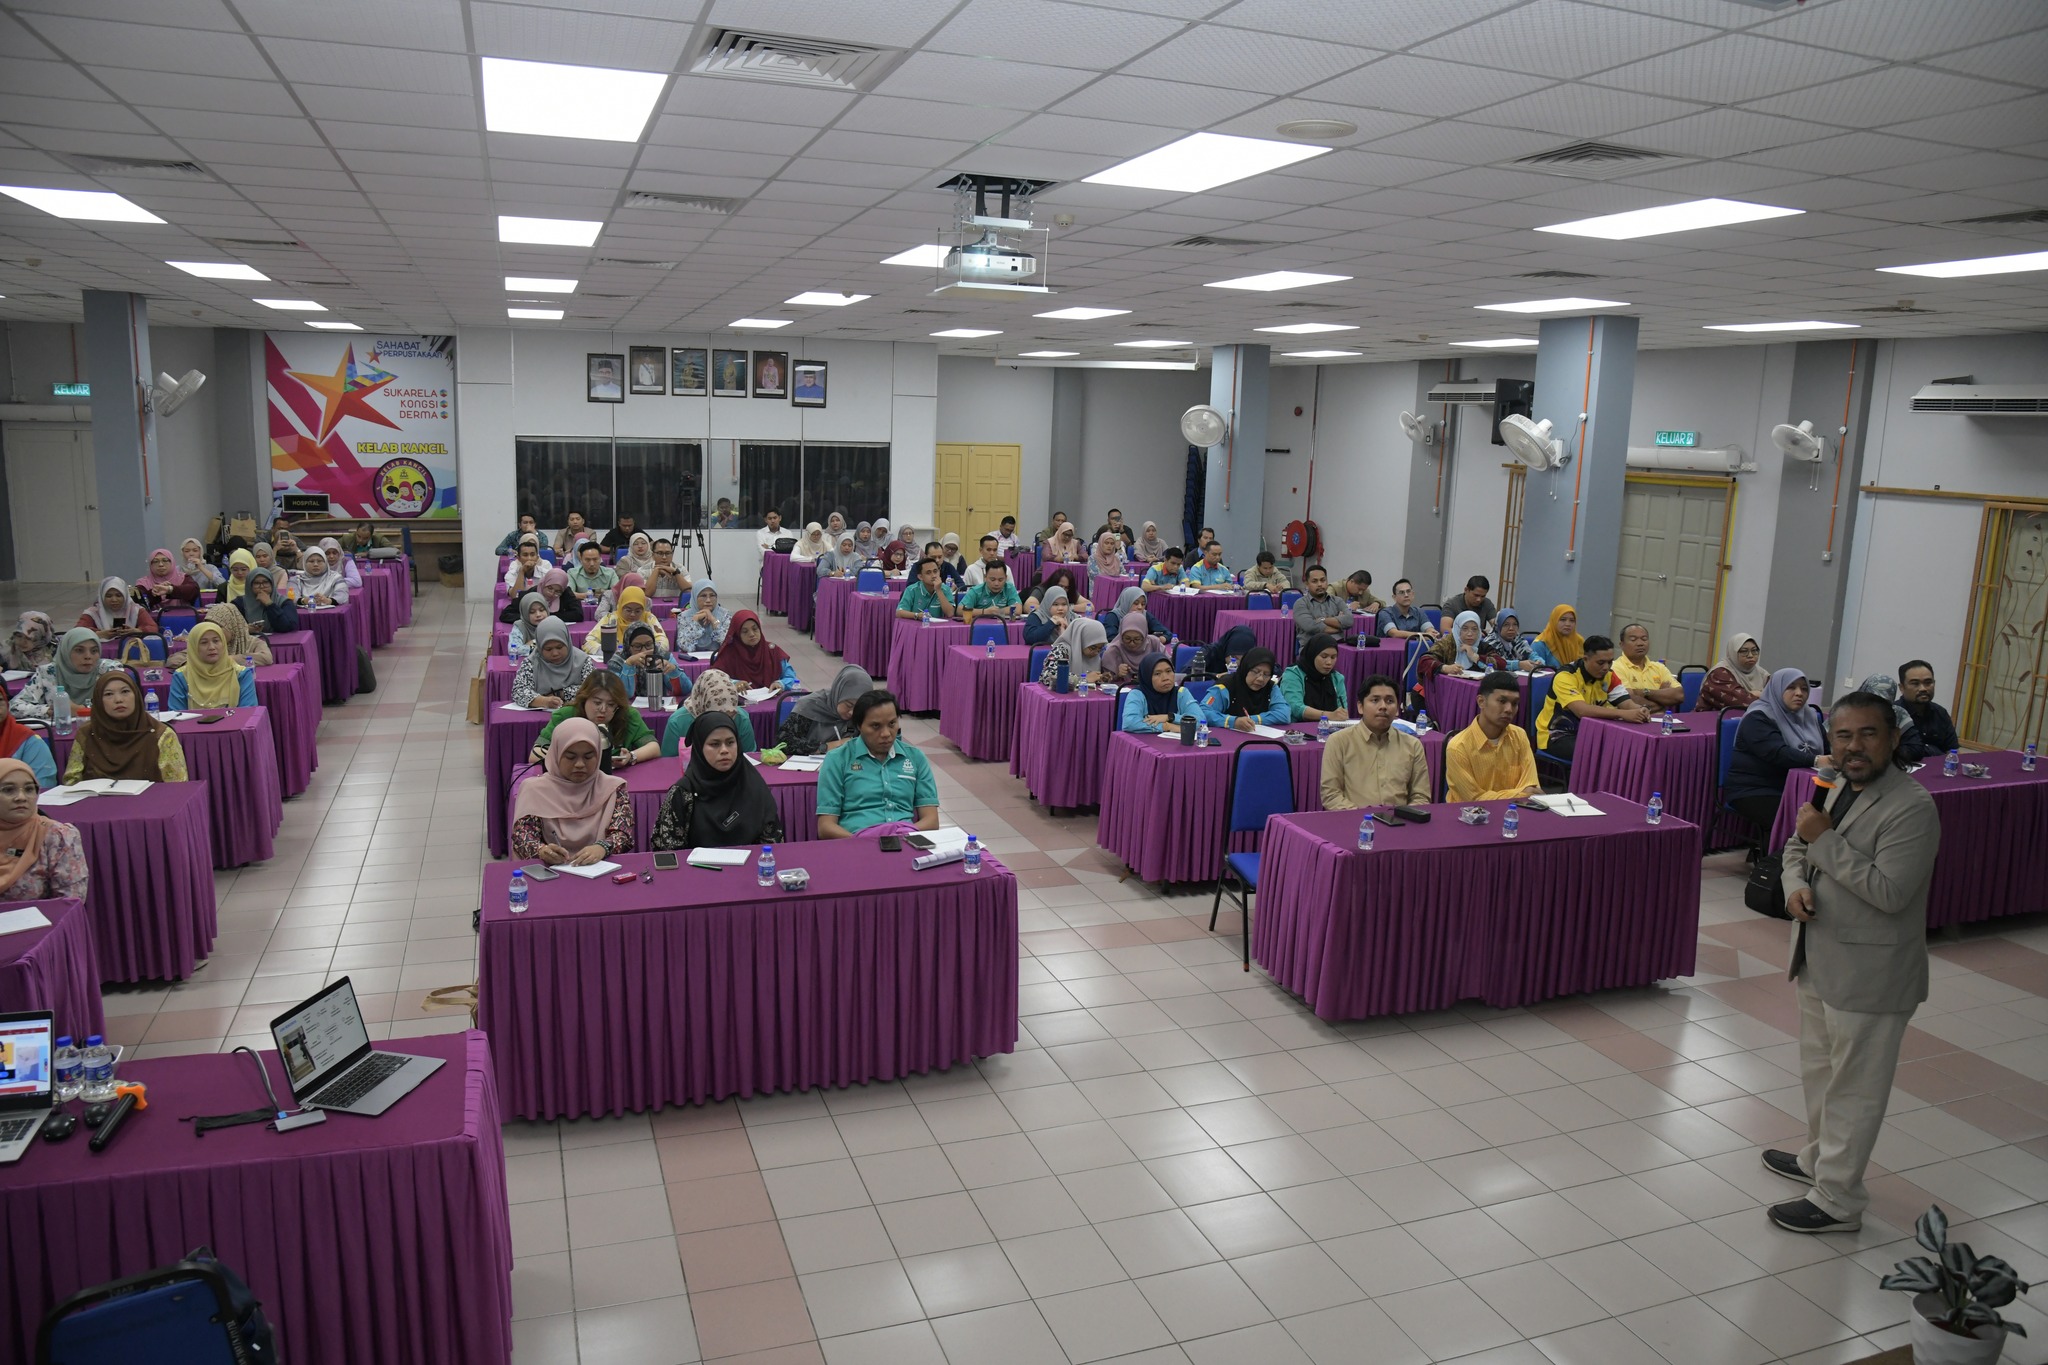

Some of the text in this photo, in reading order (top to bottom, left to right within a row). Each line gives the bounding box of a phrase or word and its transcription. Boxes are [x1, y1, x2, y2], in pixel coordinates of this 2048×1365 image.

[377, 340, 421, 350] SAHABAT
[54, 385, 90, 395] KELUAR
[384, 388, 438, 397] SUKARELA
[400, 400, 438, 408] KONGSI
[400, 411, 438, 419] DERMA
[1656, 432, 1686, 444] KELUAR
[357, 442, 448, 455] KELAB KANCIL
[380, 460, 427, 476] KELAB KANCIL
